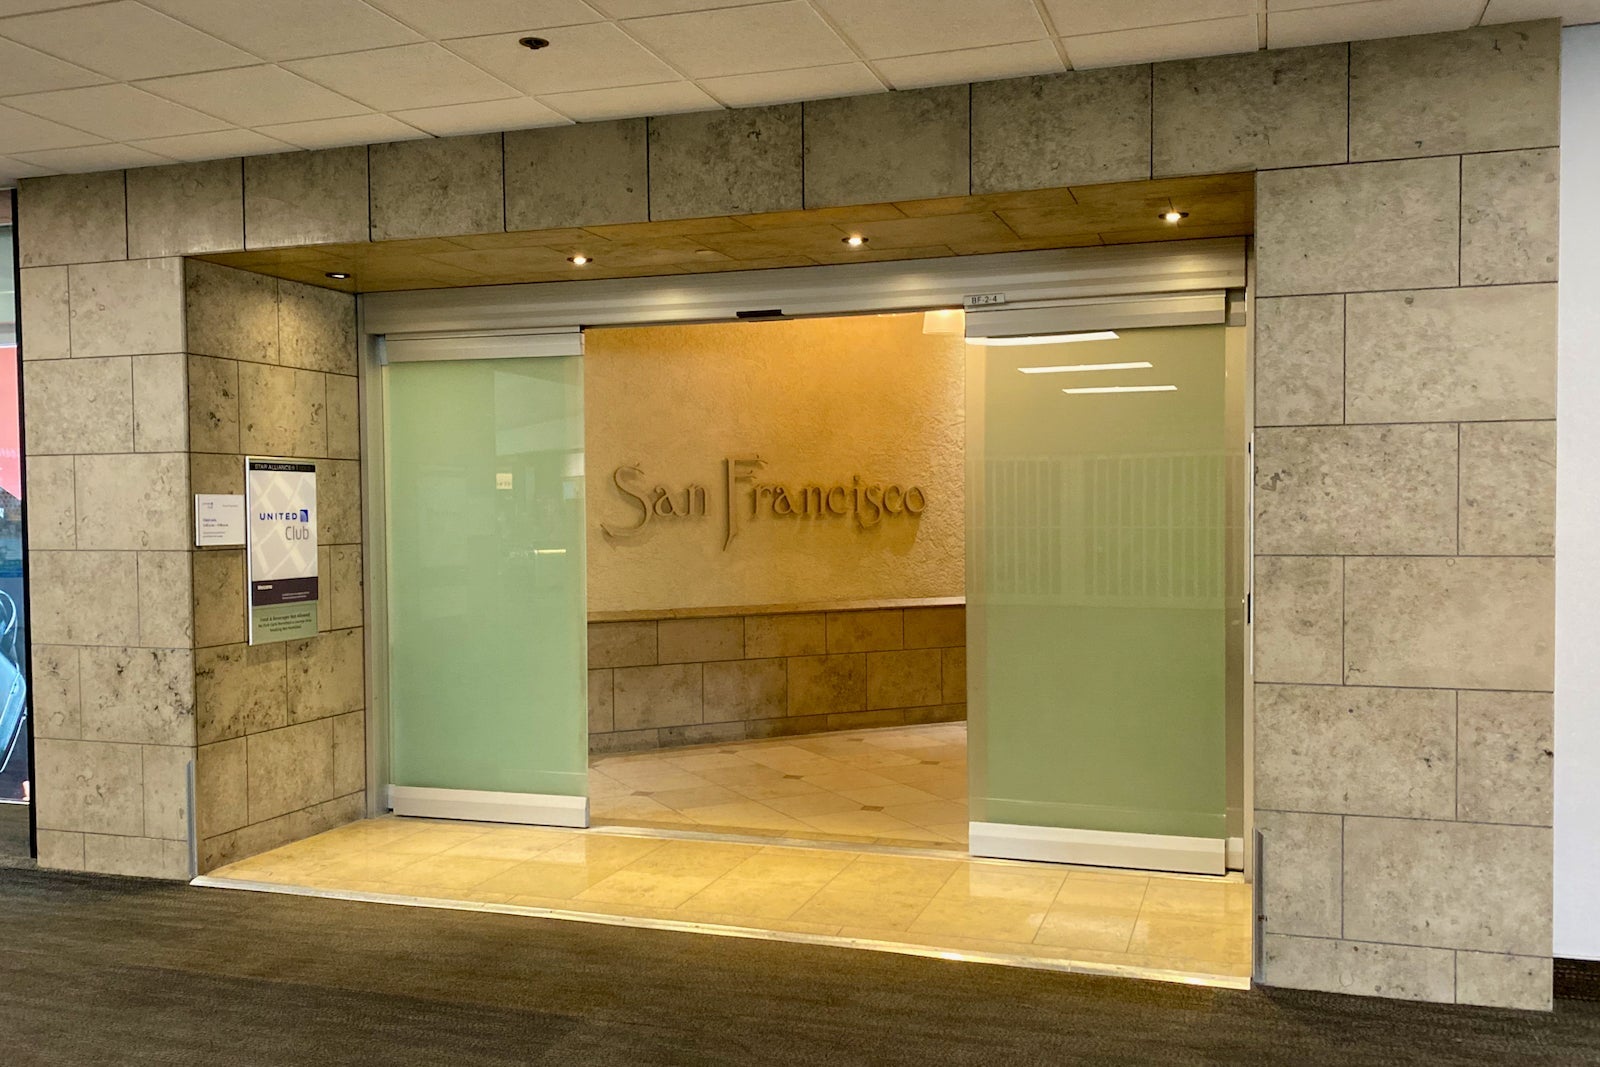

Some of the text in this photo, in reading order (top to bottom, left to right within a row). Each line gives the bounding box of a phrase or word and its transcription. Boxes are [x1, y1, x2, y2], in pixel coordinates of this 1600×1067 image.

[600, 454, 926, 551] San Francisco
[259, 512, 298, 521] UNITED
[285, 526, 309, 541] Club
